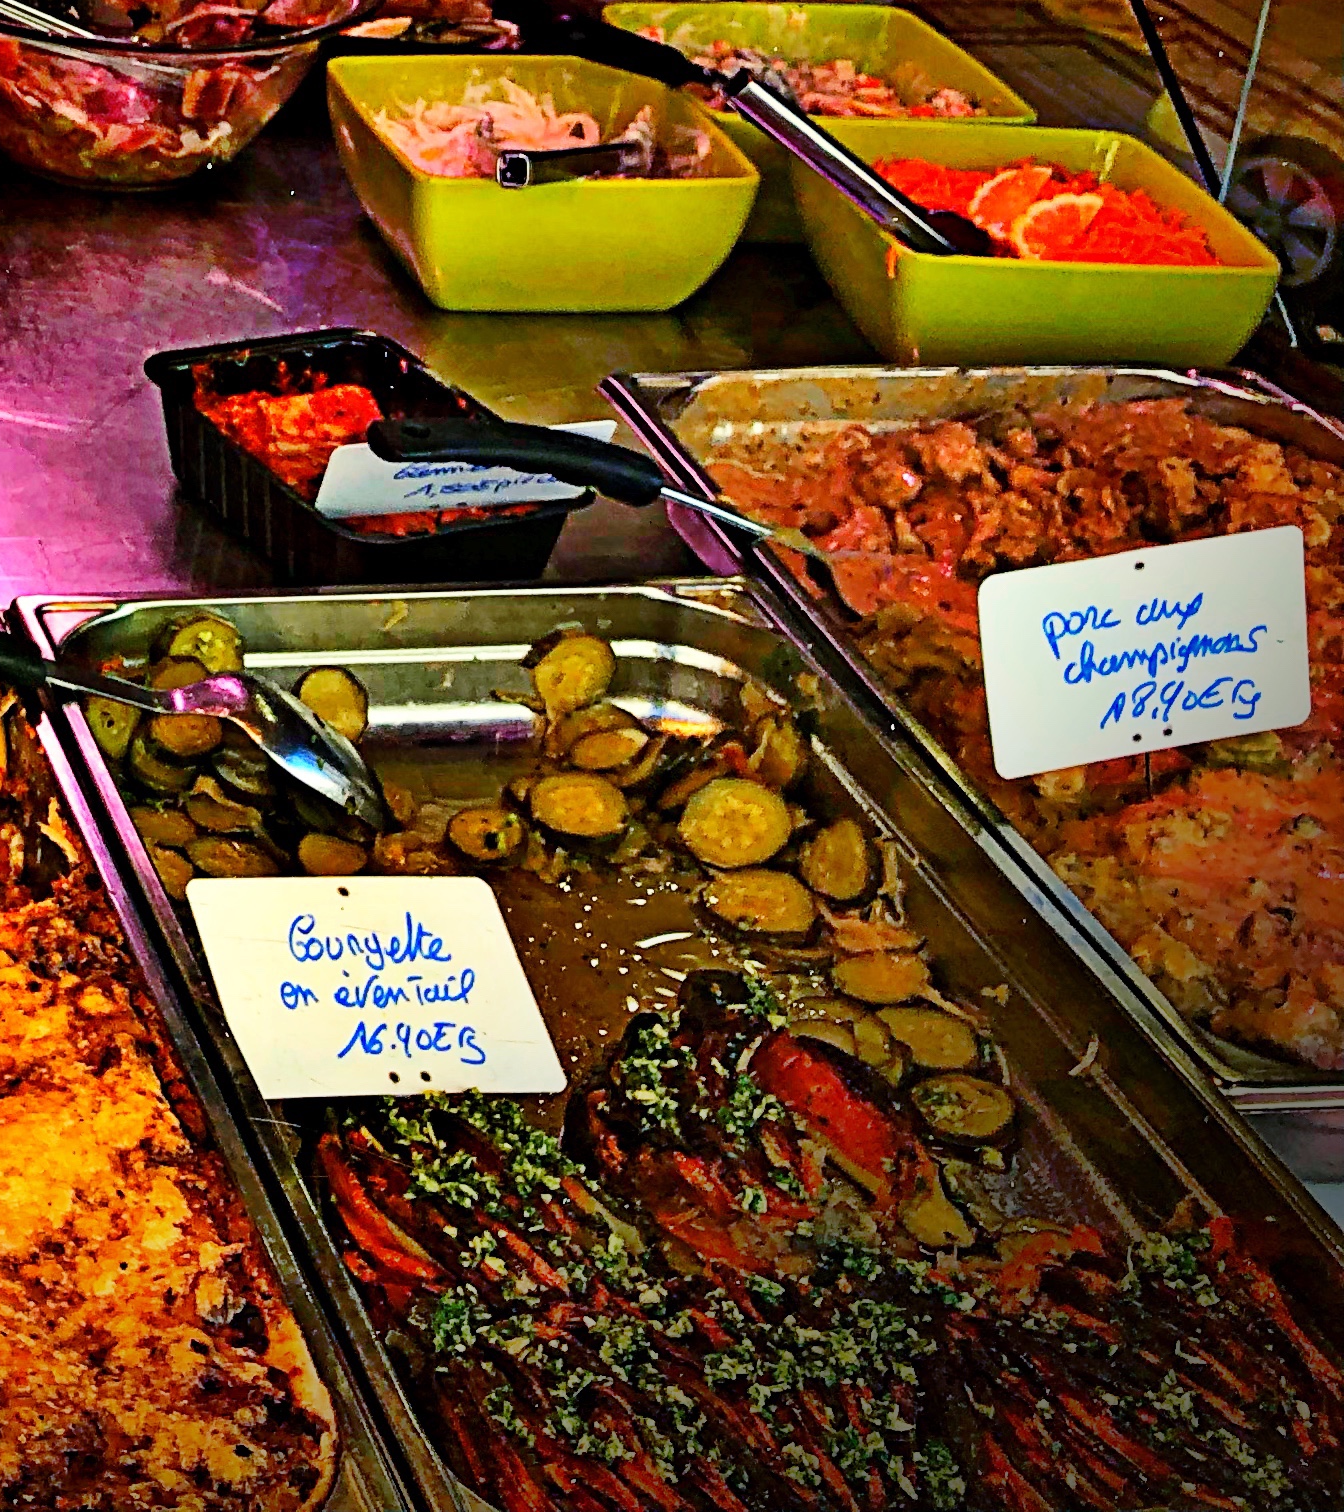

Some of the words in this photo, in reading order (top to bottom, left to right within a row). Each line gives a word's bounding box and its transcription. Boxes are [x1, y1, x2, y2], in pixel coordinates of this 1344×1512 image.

[1042, 605, 1121, 660] porc
[1136, 592, 1203, 628] aux
[1064, 625, 1267, 685] champignons
[288, 912, 452, 970] Courgette
[280, 981, 319, 1010] en
